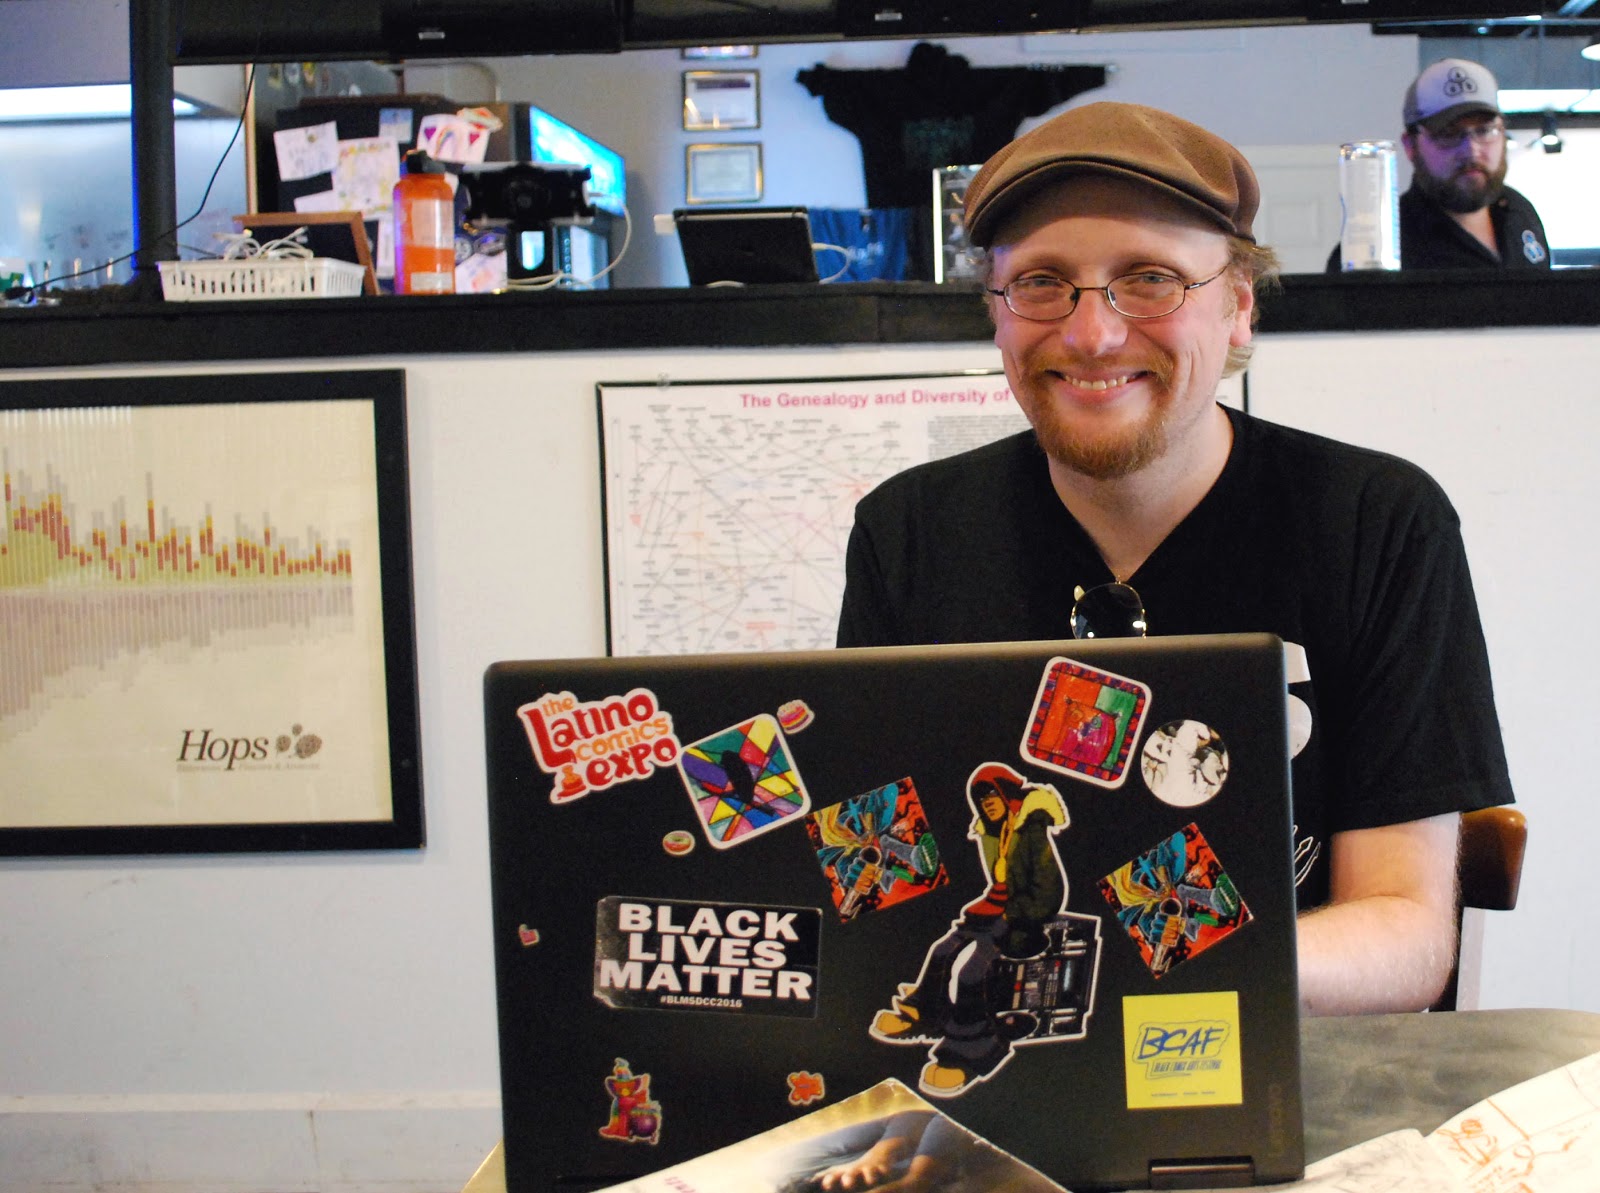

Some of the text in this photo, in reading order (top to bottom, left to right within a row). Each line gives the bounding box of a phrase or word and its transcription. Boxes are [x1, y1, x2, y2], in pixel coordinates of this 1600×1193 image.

[740, 388, 1010, 409] The Genealogy and Diversity of
[542, 697, 574, 716] the
[176, 728, 269, 771] Hops
[524, 694, 654, 768] Latino
[575, 716, 669, 761] comics
[619, 903, 799, 941] BLACK
[629, 932, 787, 969] LIVES
[600, 959, 812, 1000] MATTER
[660, 995, 743, 1009] #BLMSDCC2016
[1137, 1026, 1225, 1060] BCAF
